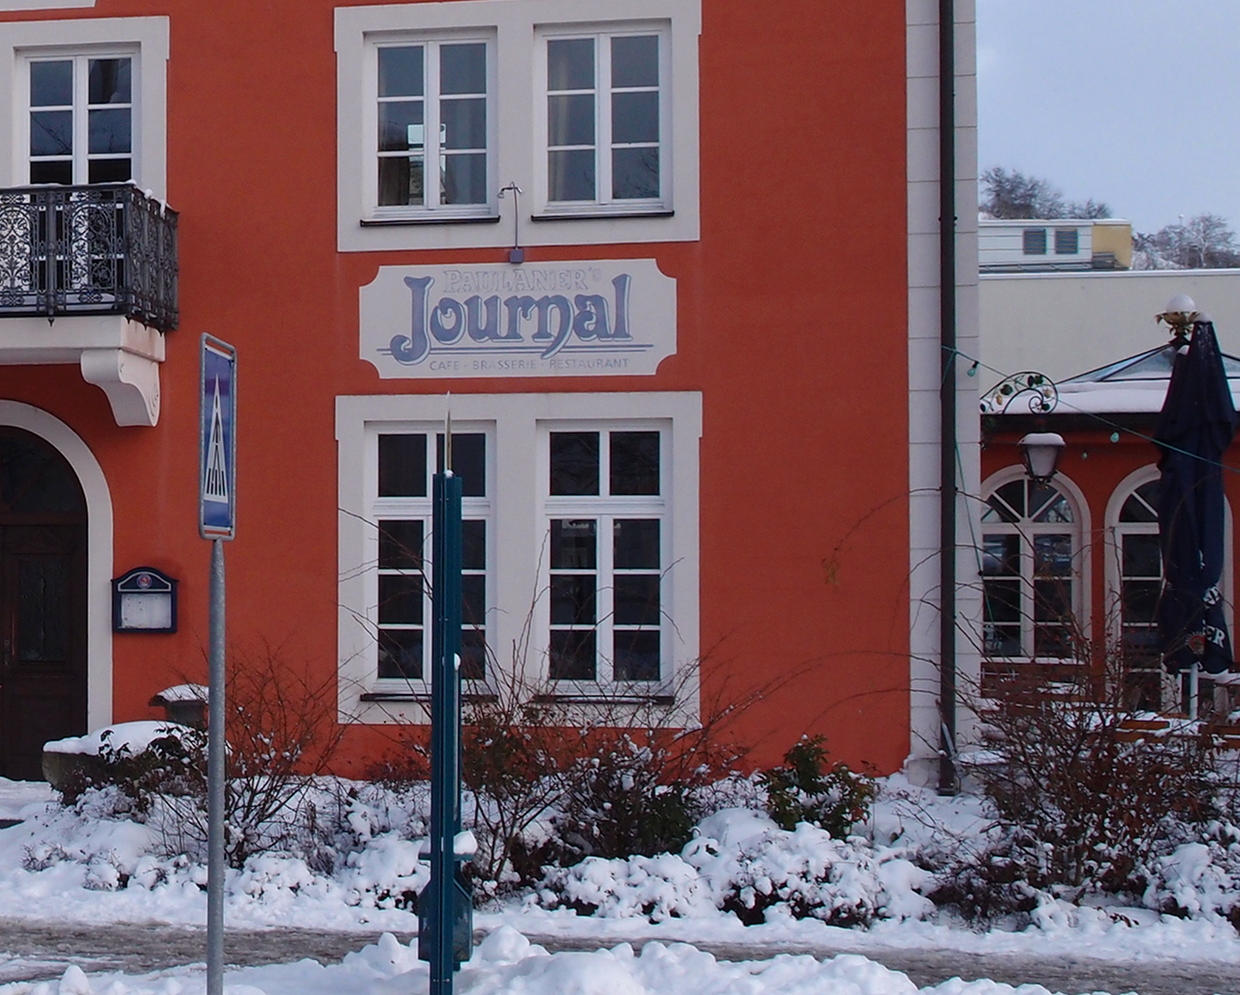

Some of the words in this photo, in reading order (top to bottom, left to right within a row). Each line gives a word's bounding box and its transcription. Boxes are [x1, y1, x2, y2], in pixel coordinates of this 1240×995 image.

[390, 273, 633, 365] Journal
[472, 359, 537, 370] BRASSERIE
[549, 358, 629, 369] RESTAURANT
